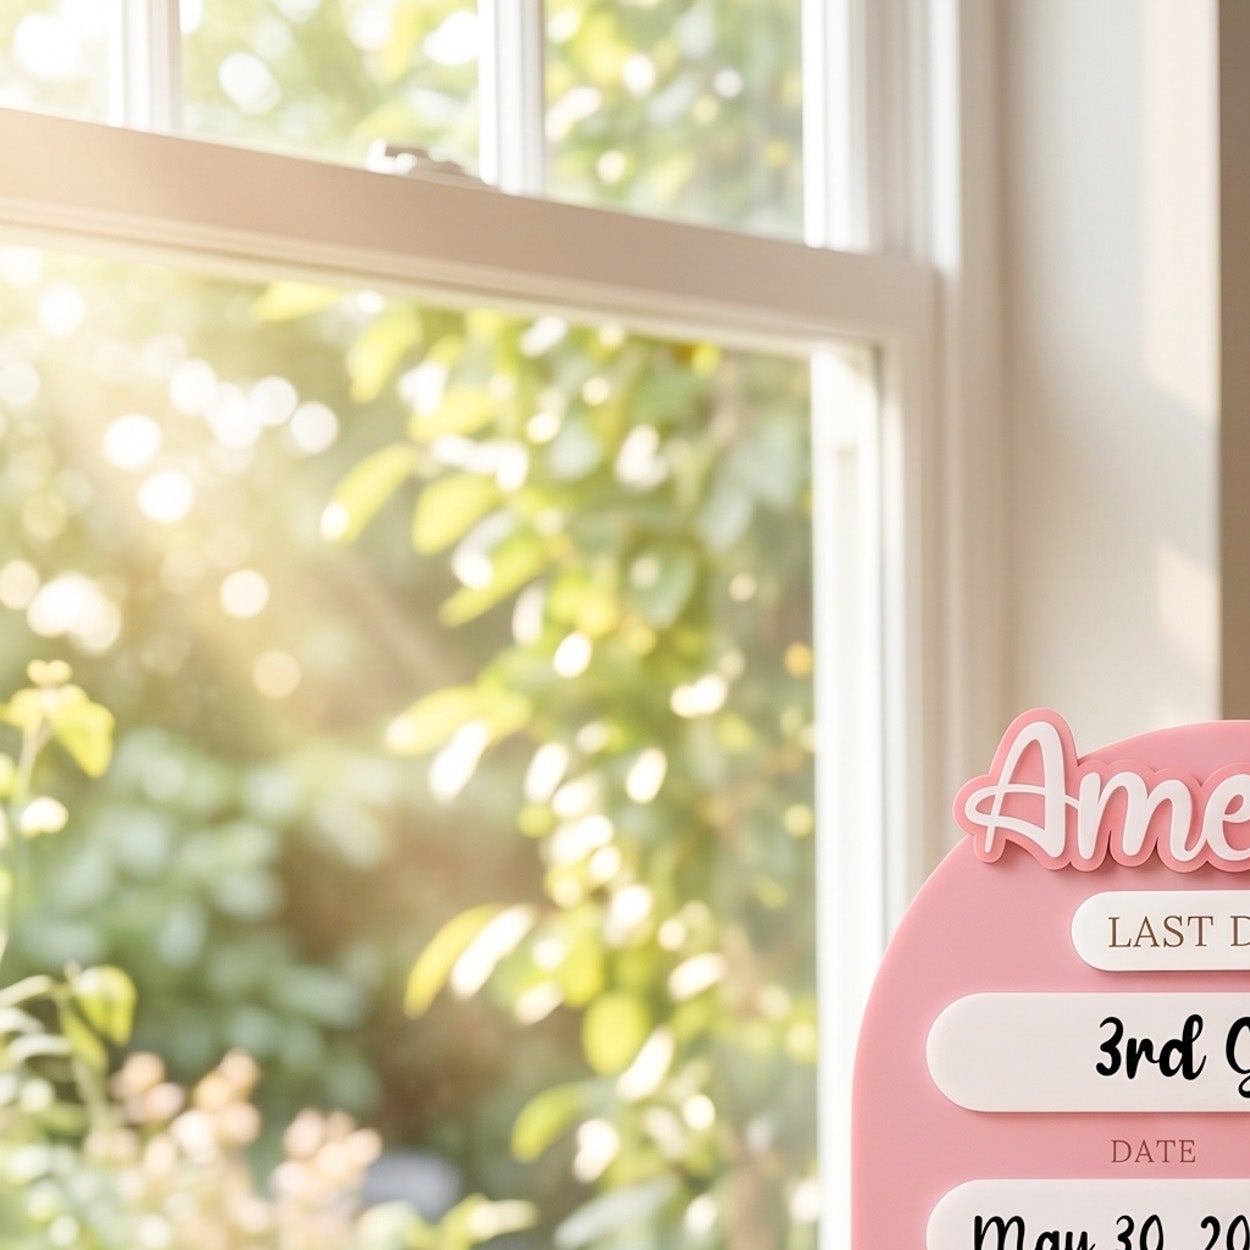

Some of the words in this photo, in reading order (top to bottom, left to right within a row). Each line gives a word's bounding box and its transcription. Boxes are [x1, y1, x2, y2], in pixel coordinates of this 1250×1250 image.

[1108, 915, 1214, 948] LAST
[1096, 1014, 1206, 1080] 3rd
[1111, 1139, 1195, 1163] DATE
